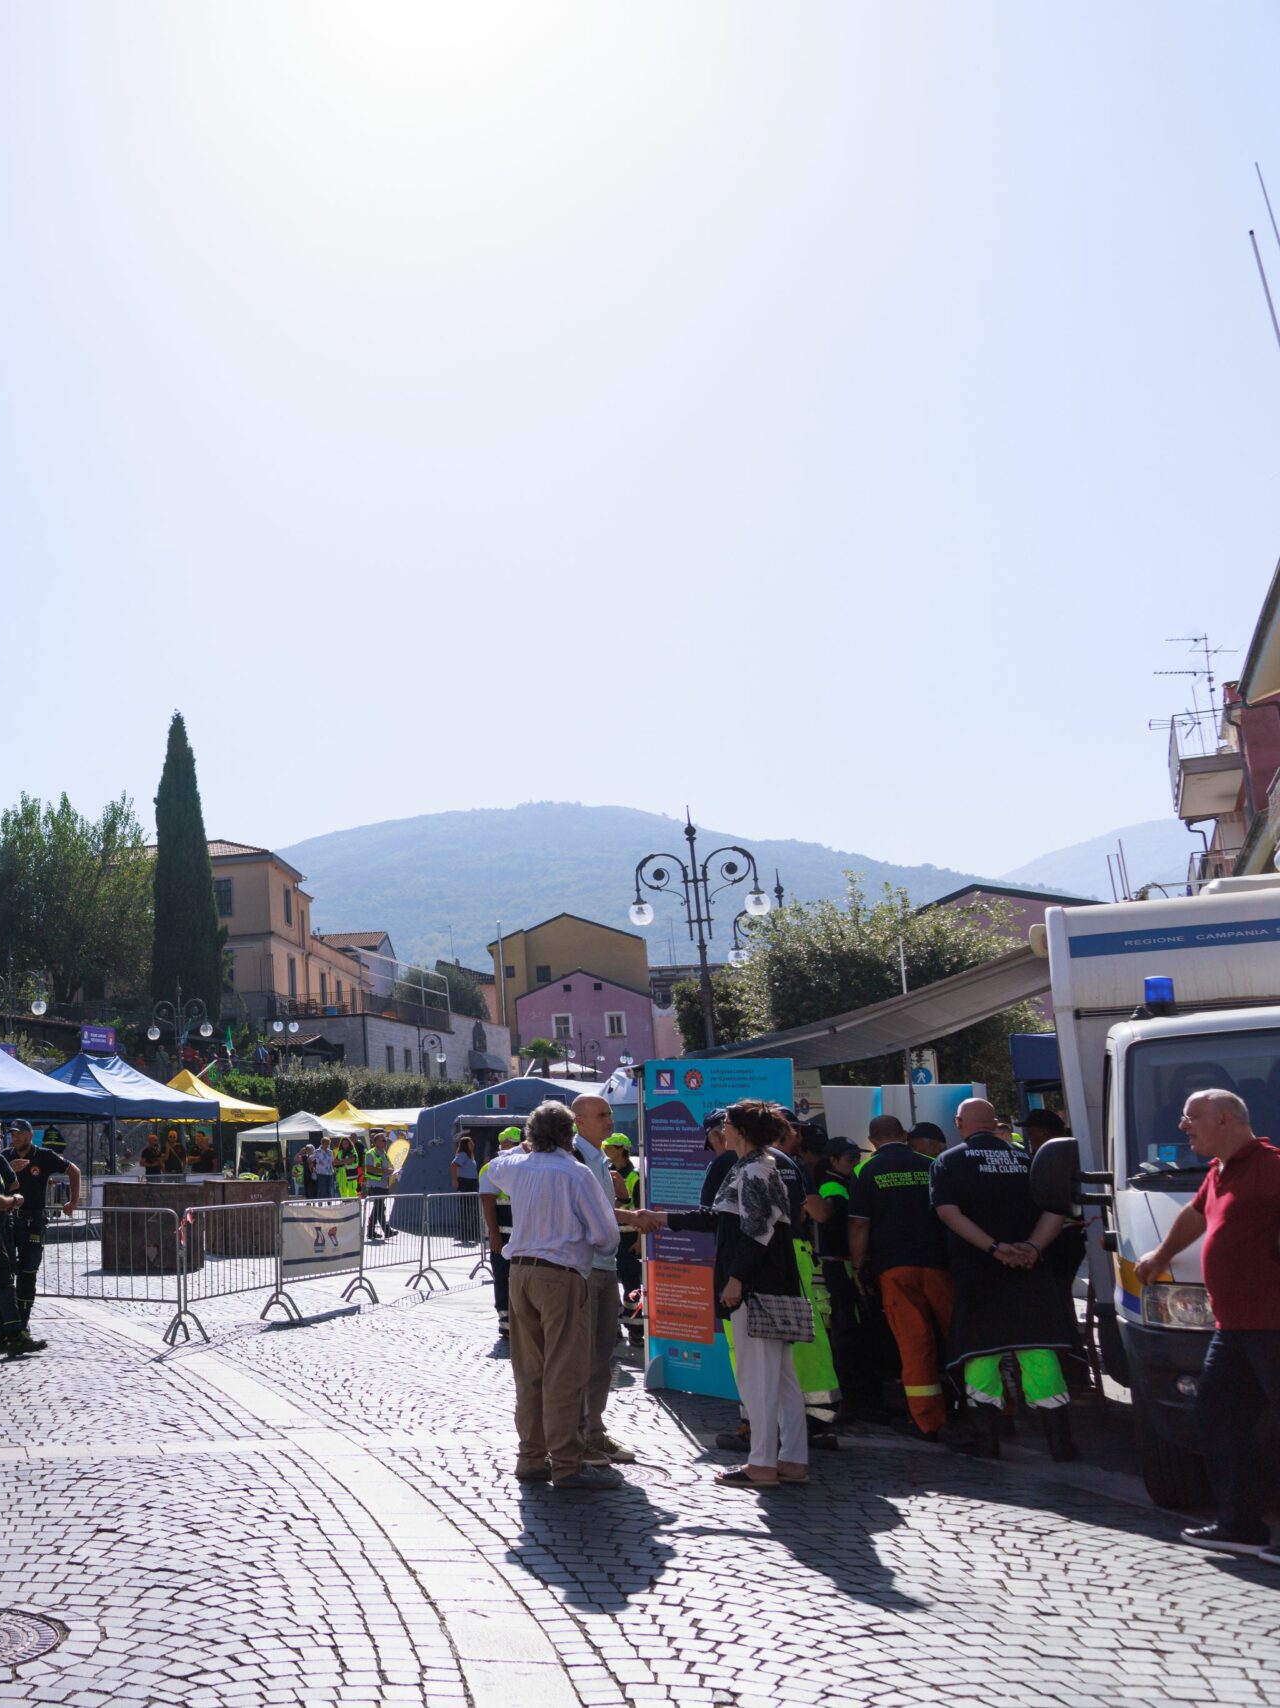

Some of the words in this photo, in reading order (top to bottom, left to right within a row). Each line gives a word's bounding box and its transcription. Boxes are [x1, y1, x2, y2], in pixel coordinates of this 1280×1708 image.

[1124, 936, 1185, 946] REGIONE
[1195, 928, 1269, 940] CAMPANIA
[965, 1150, 1009, 1158] PROTEZIONE
[979, 1164, 998, 1173] AREA
[998, 1165, 1028, 1174] CILENTO
[874, 1172, 912, 1182] PROTEZIONE
